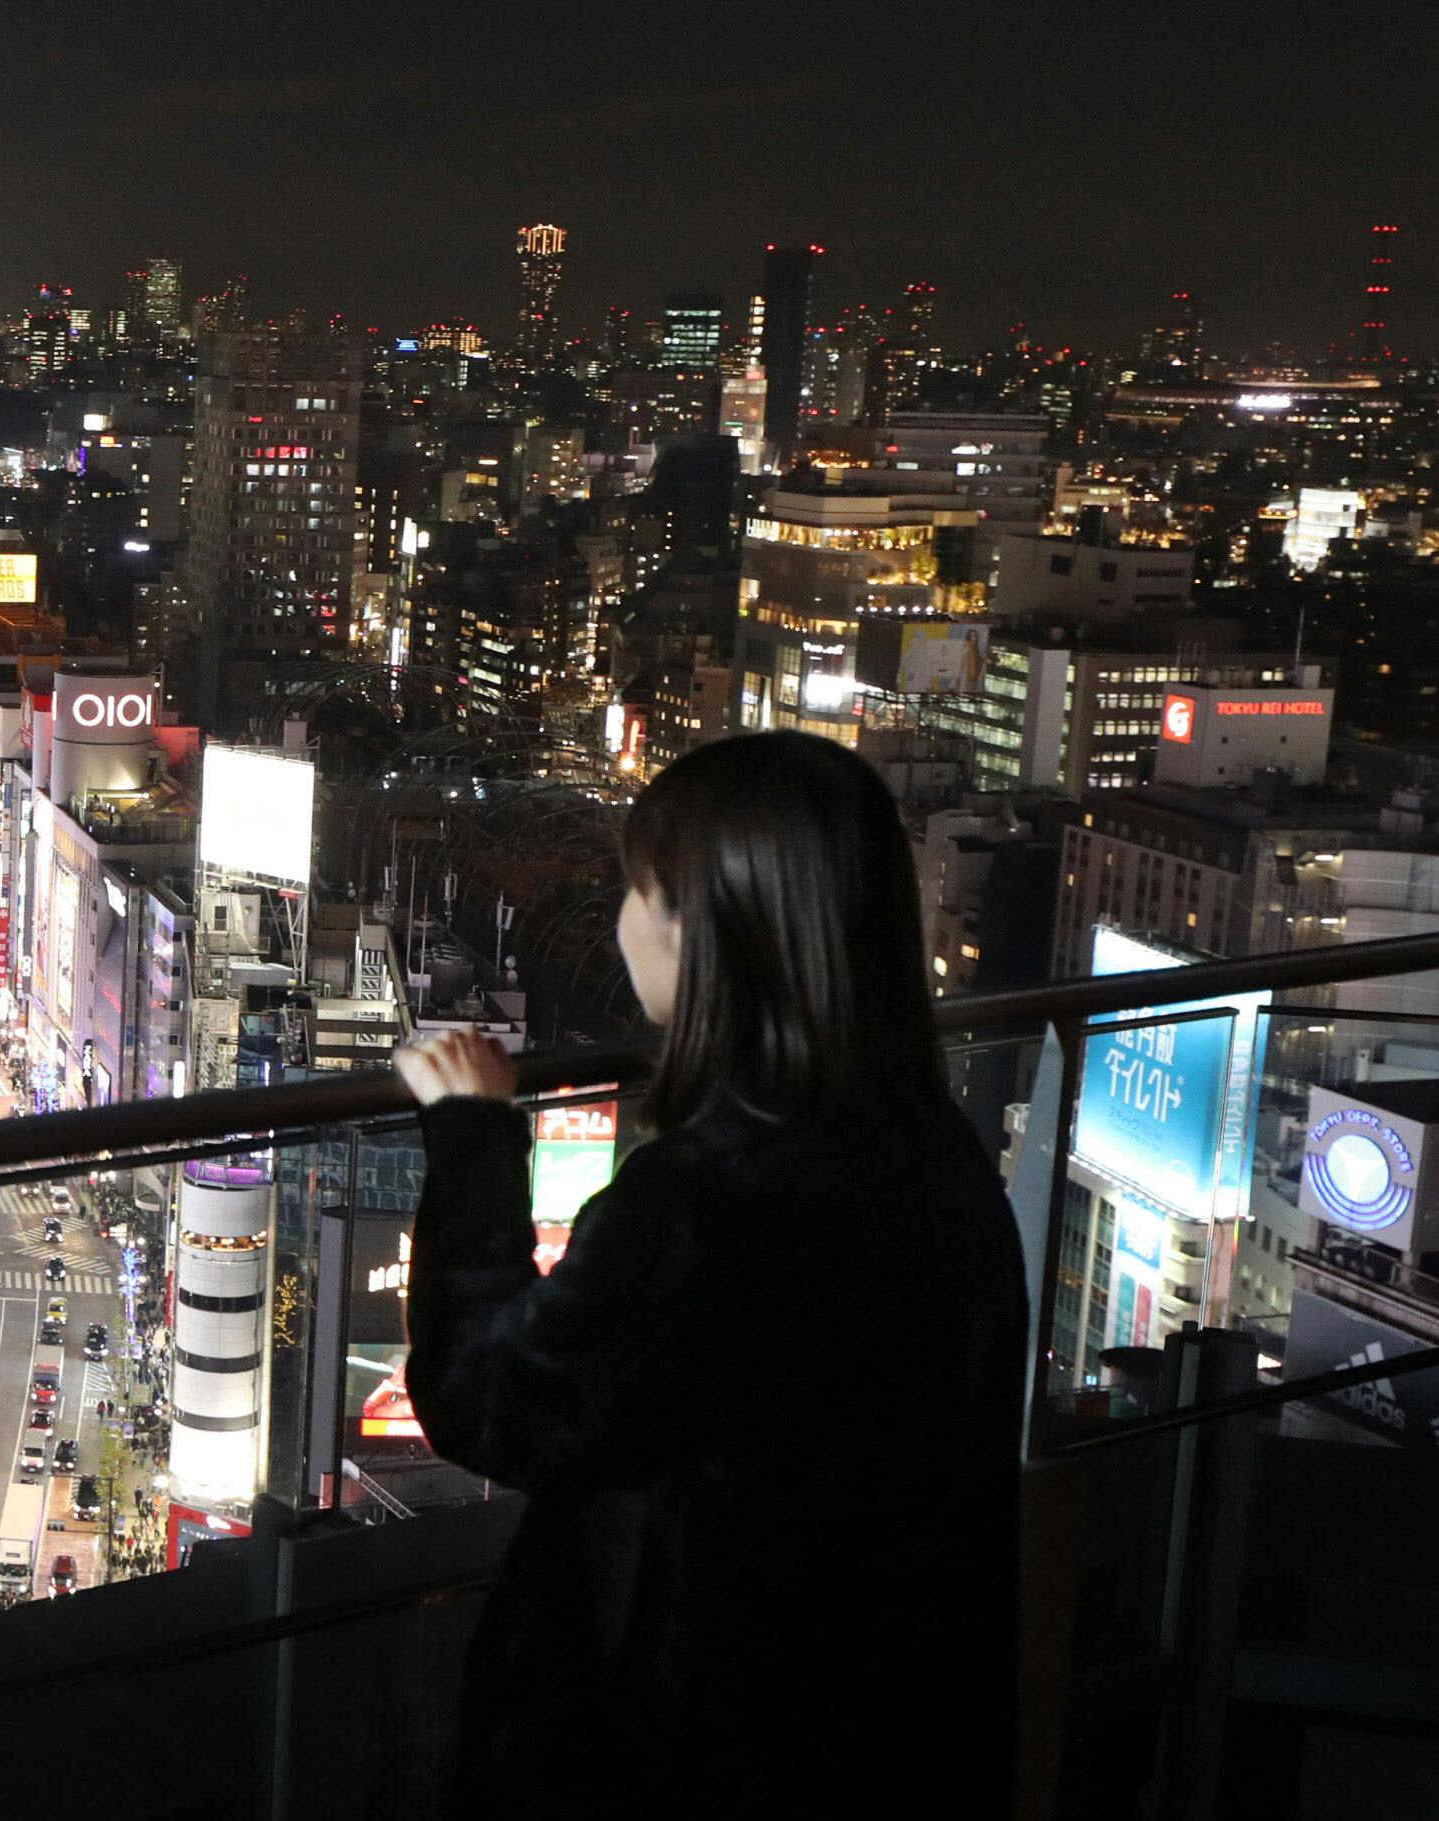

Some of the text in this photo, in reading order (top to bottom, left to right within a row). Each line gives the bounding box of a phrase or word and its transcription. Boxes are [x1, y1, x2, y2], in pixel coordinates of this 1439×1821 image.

[73, 694, 152, 728] OIOI
[1217, 702, 1325, 715] TOKYU REI HOTEL
[1310, 1111, 1344, 1142] TOKYU
[1383, 1126, 1414, 1172] STORE
